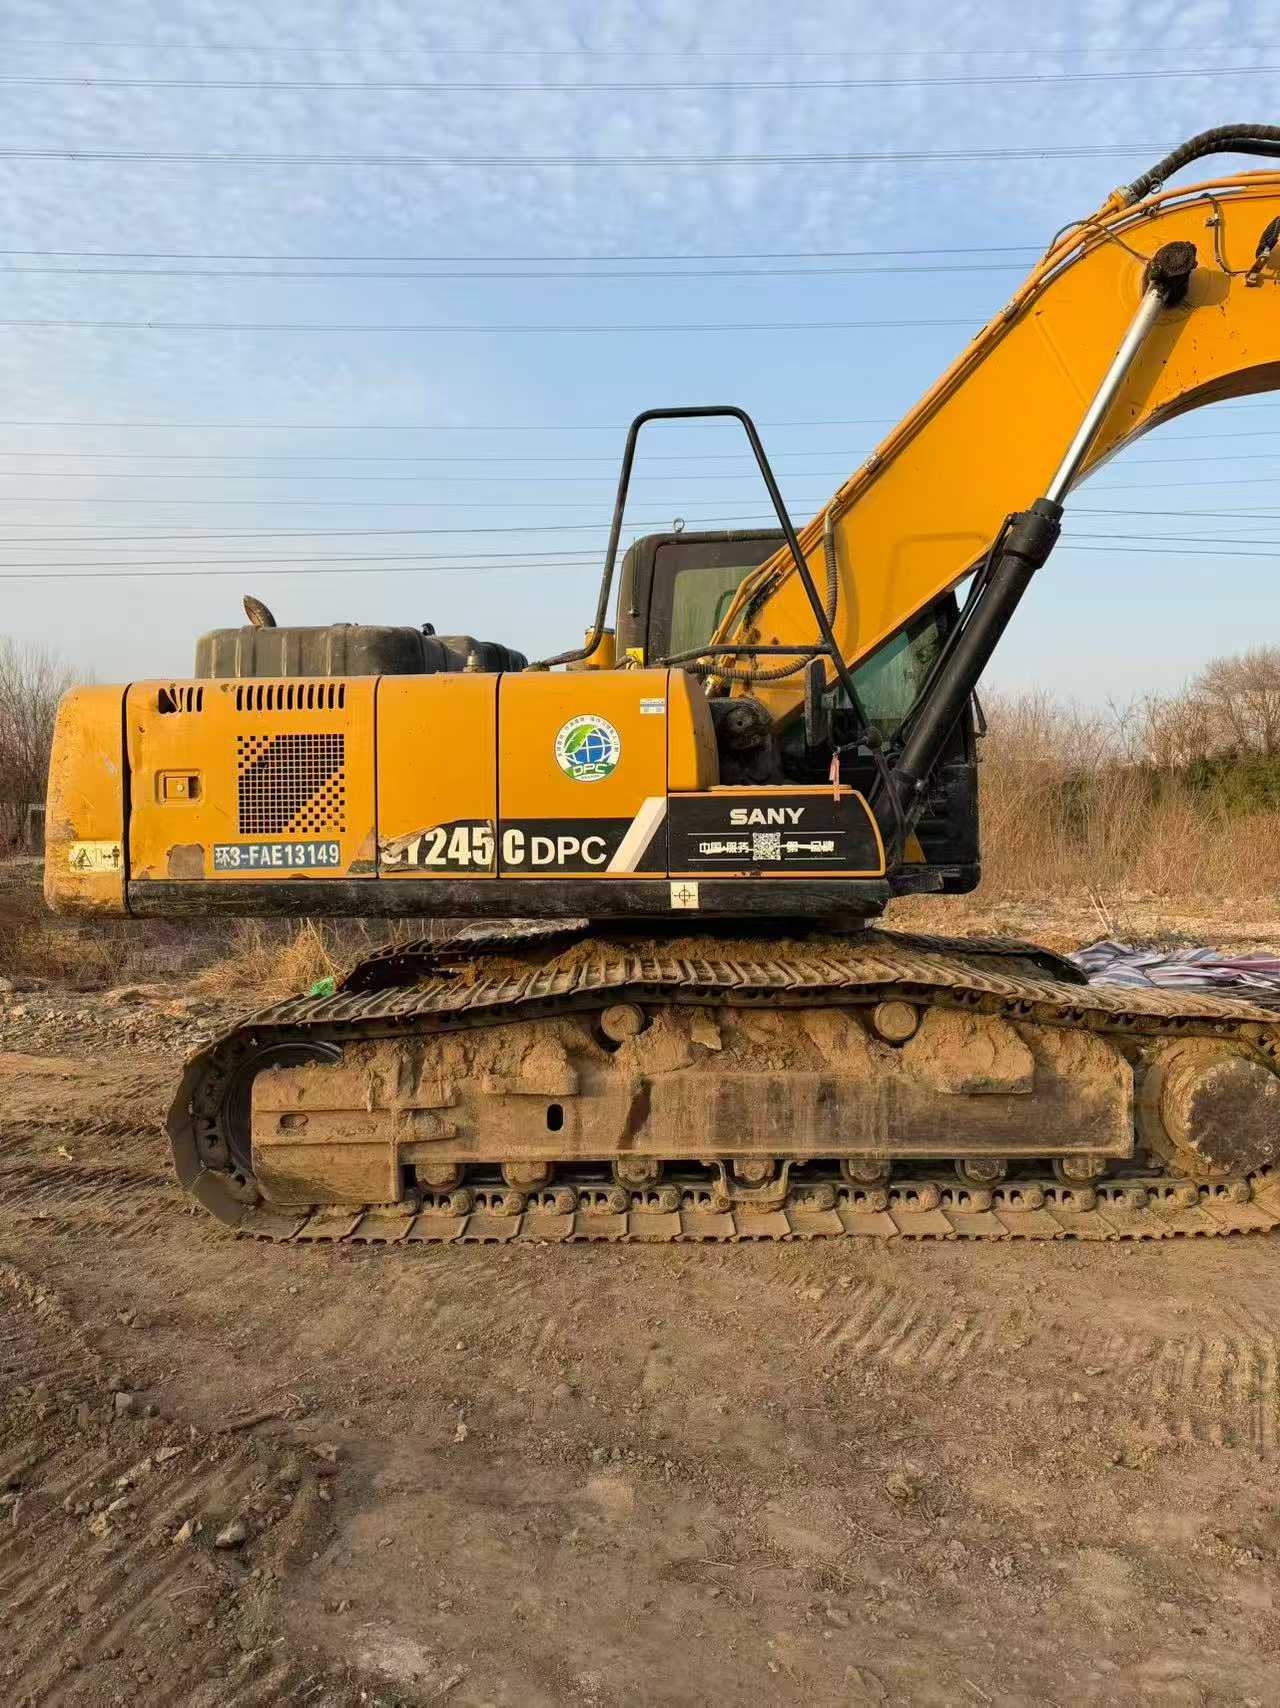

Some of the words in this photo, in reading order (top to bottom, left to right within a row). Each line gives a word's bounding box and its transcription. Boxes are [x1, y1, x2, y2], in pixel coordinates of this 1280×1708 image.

[572, 763, 607, 776] DPC
[729, 808, 805, 825] SANY
[531, 836, 607, 864] DPC
